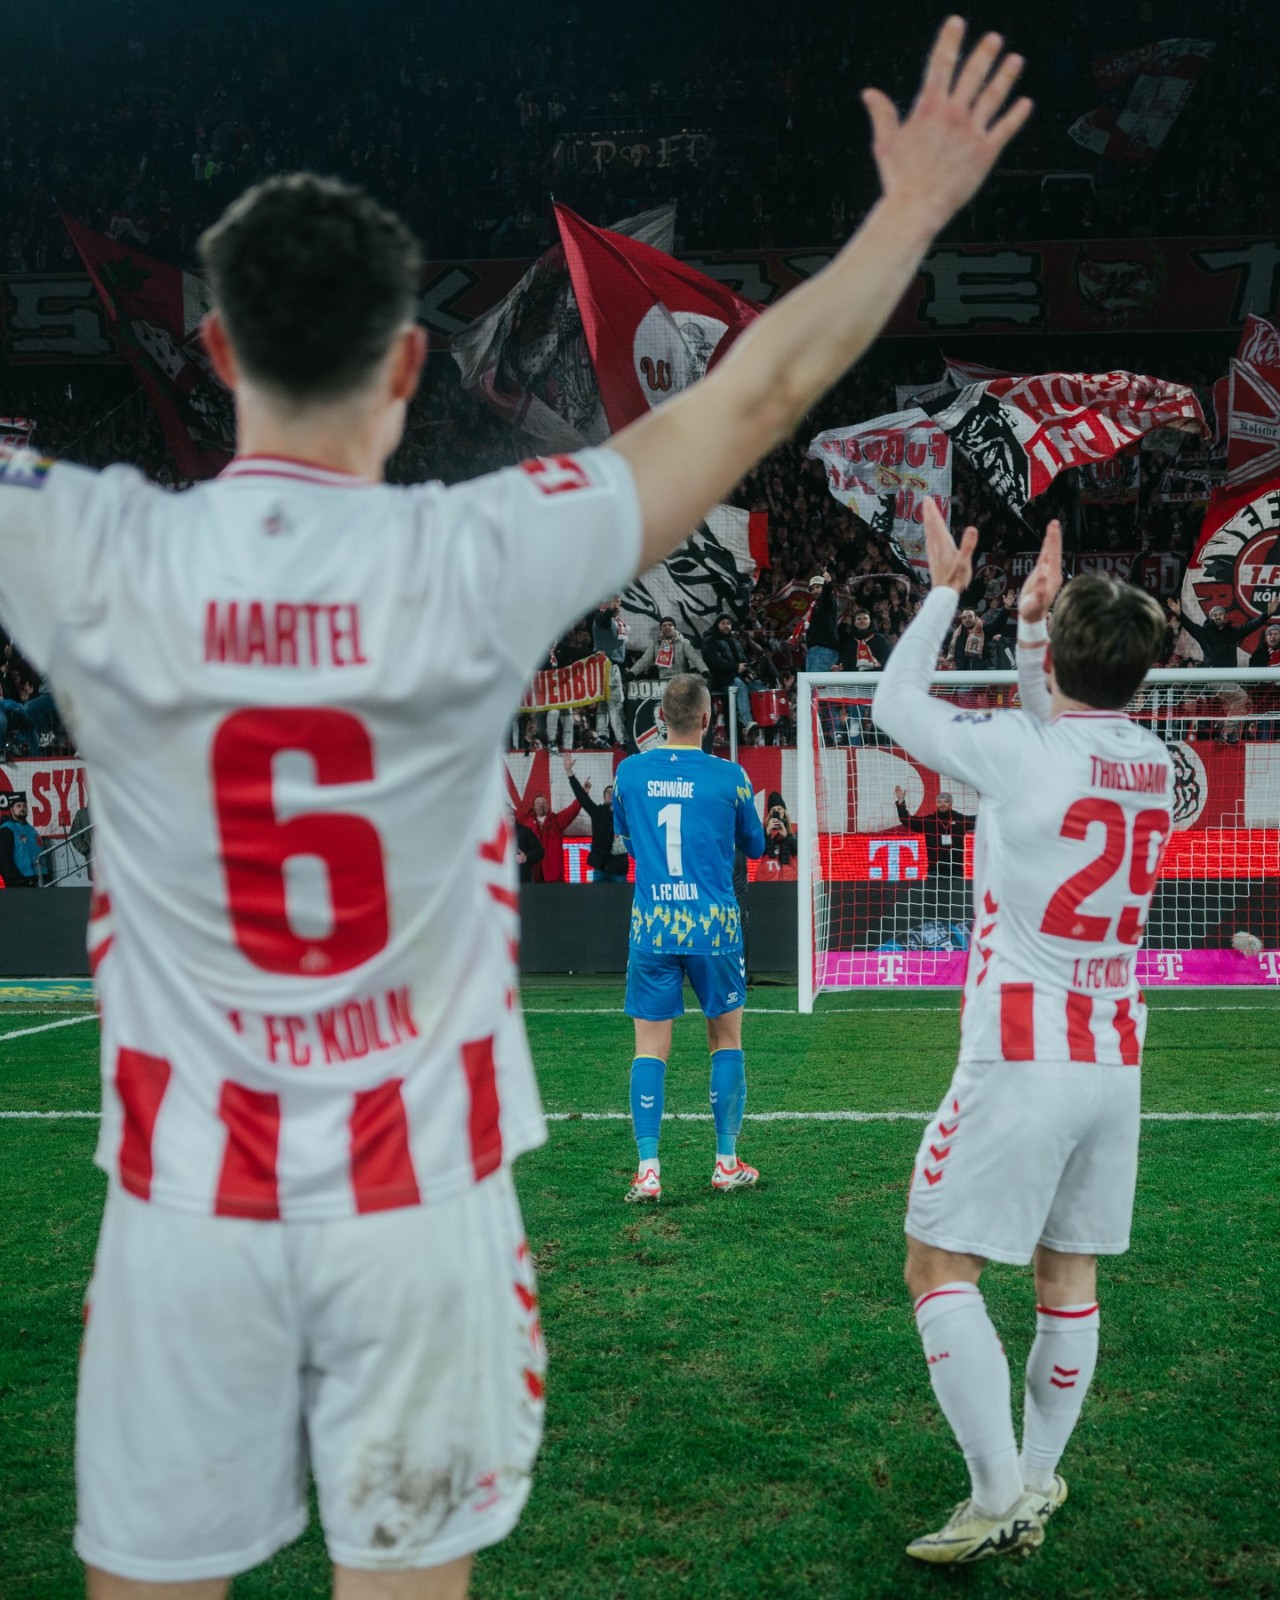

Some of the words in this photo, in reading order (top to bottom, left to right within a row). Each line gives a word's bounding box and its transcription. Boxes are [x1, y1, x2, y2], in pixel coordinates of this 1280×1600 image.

[206, 601, 366, 667] MARTEL
[647, 776, 695, 799] SCHWÄBE
[213, 708, 390, 975] 6
[657, 803, 683, 877] 1
[869, 840, 918, 882] T
[660, 884, 672, 900] FC
[673, 880, 699, 900] KÖLN
[1040, 798, 1170, 945] 29
[878, 955, 903, 982] T
[1157, 953, 1183, 981] T
[264, 1015, 311, 1066] FC
